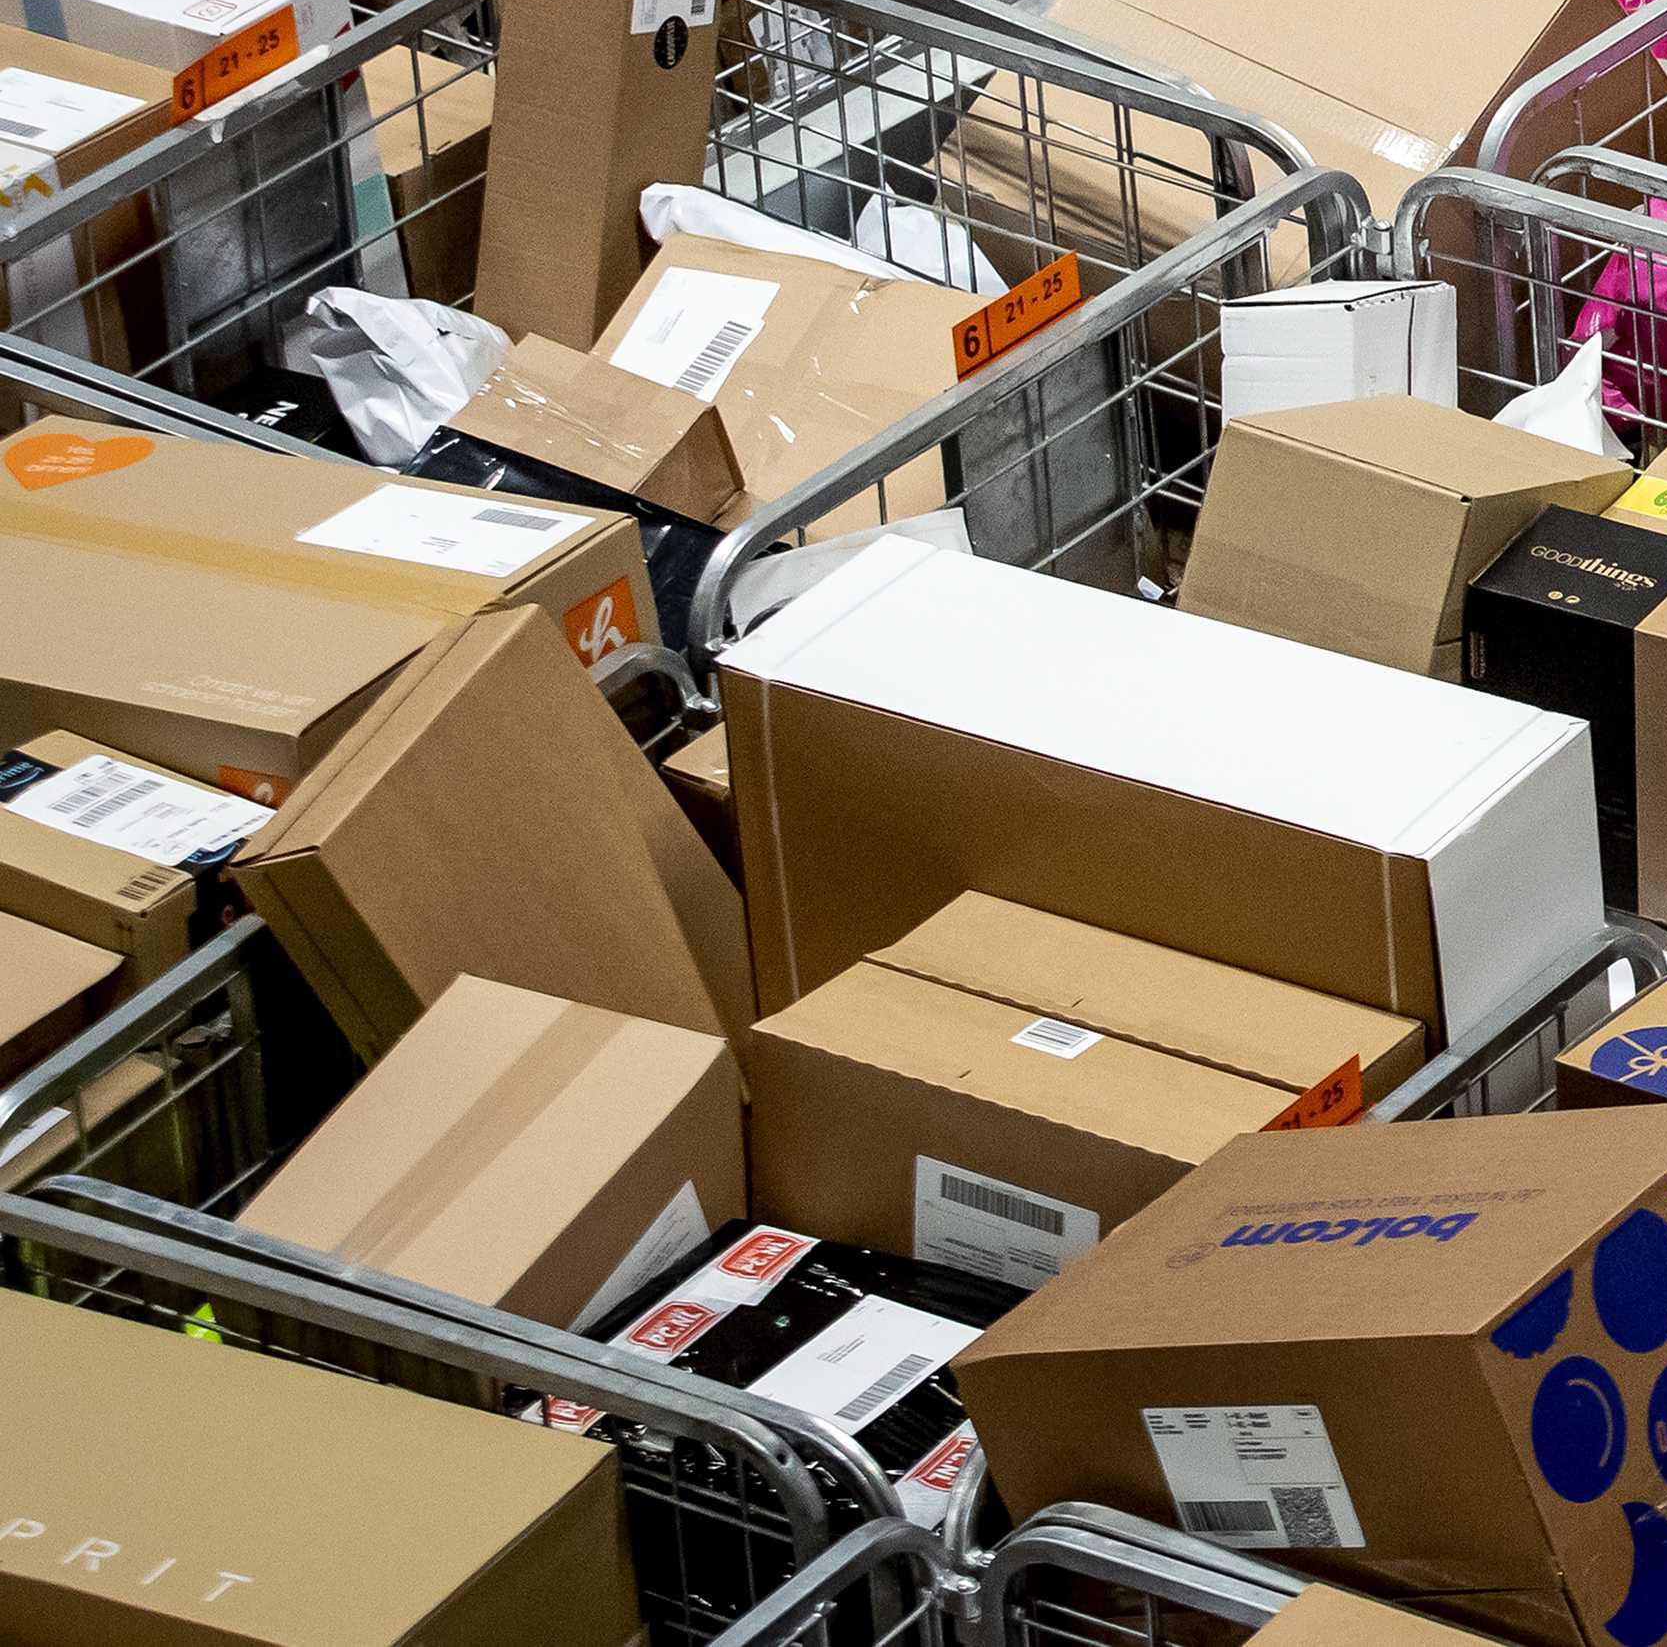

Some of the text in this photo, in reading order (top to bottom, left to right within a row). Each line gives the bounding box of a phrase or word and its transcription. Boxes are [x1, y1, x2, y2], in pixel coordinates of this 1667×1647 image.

[220, 31, 280, 76] 21 25
[181, 78, 196, 108] 6
[1005, 272, 1063, 322] 21 25
[963, 326, 980, 357] 6
[1530, 543, 1658, 590] GOODthings
[1321, 1080, 1345, 1110] 25
[1219, 1211, 1480, 1248] bol.com
[743, 1240, 793, 1274] PC.NL
[649, 1309, 704, 1346] PC.NL
